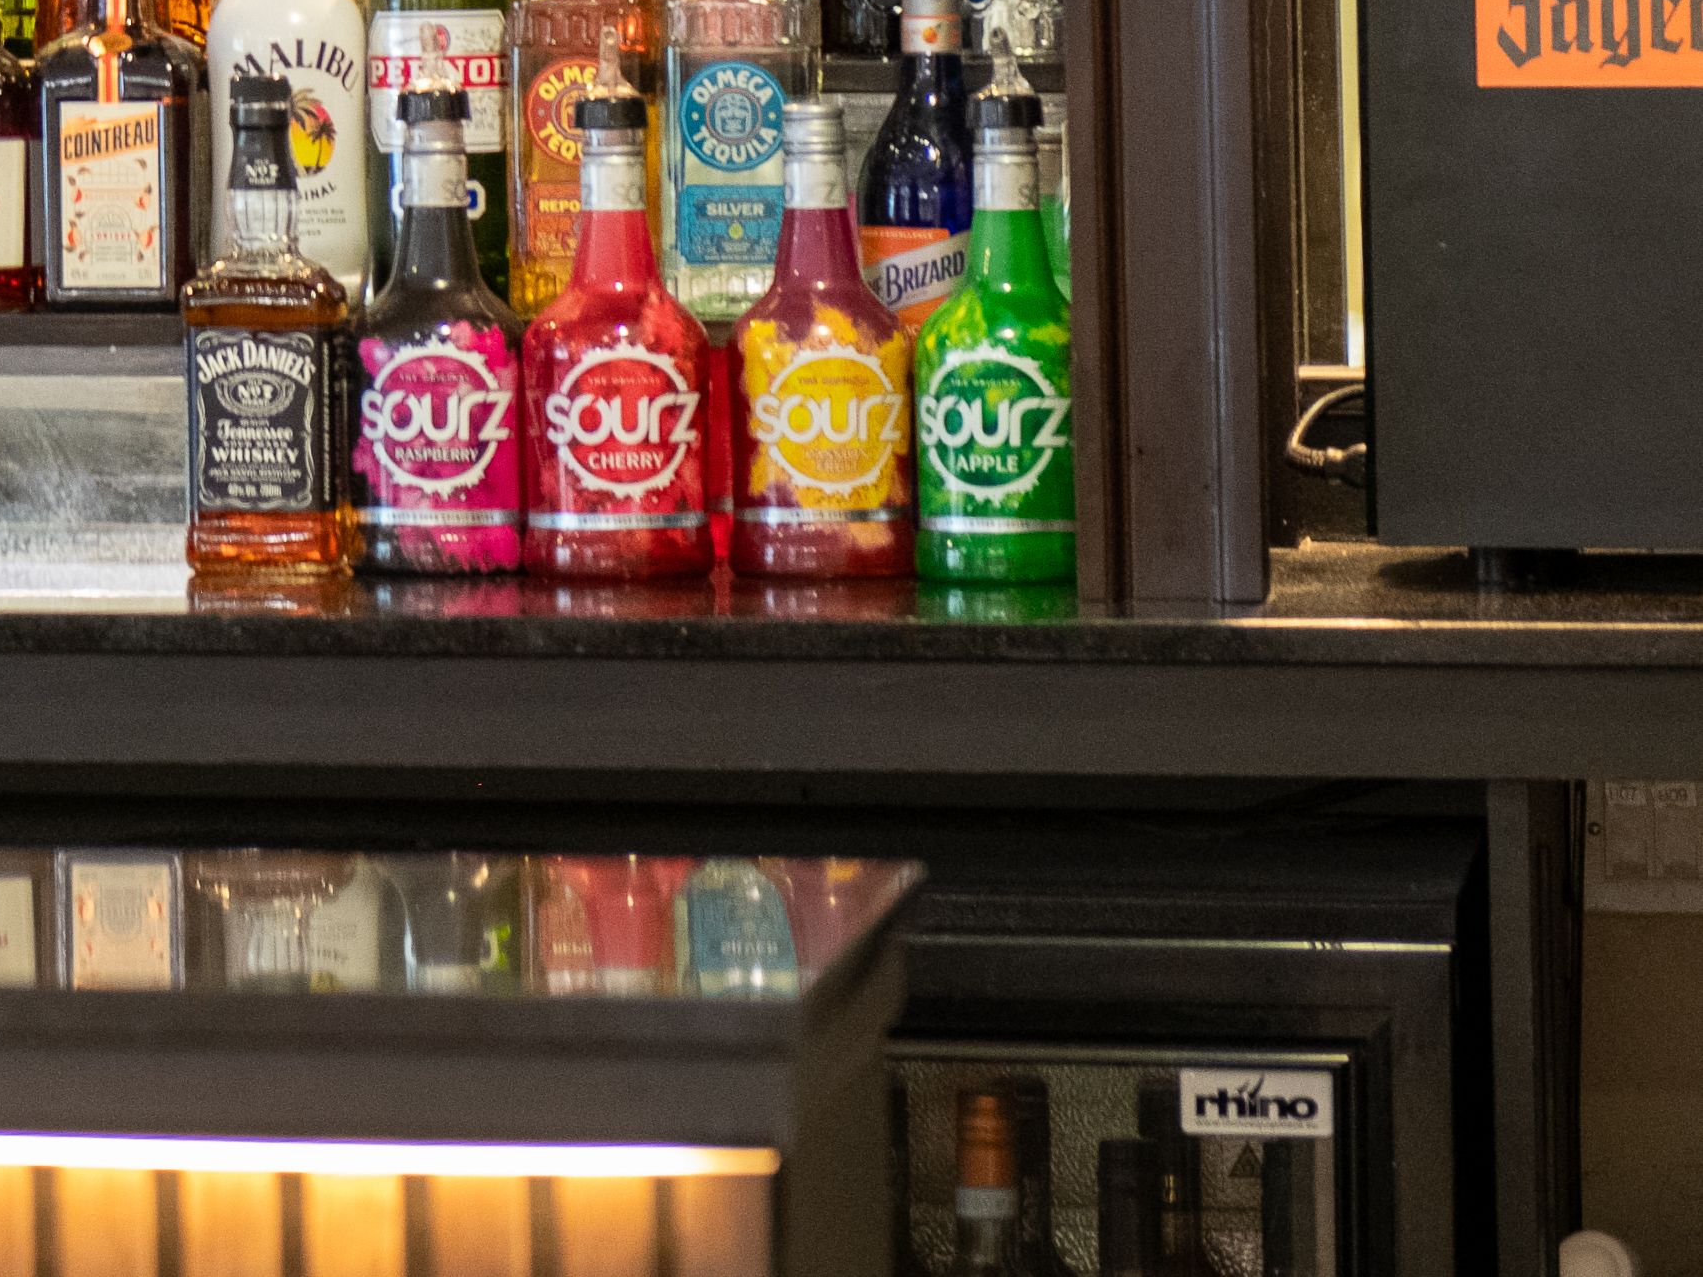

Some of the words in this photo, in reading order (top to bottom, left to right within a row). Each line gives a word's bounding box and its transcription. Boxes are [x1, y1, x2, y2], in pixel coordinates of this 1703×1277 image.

[233, 38, 359, 92] MALIBU
[692, 69, 774, 104] OLMECA
[64, 118, 155, 160] COINTREAU
[693, 126, 778, 164] TEQUILA
[706, 203, 764, 215] SILVER
[885, 250, 964, 306] BRIZARD
[197, 346, 244, 384] JACK
[243, 339, 316, 386] DANIEL'S
[212, 447, 298, 463] WHISKEY
[395, 449, 479, 462] RASPBERRY
[588, 451, 664, 469] CHERRY
[956, 454, 1019, 473] APPLE
[1196, 1073, 1318, 1119] rhino
